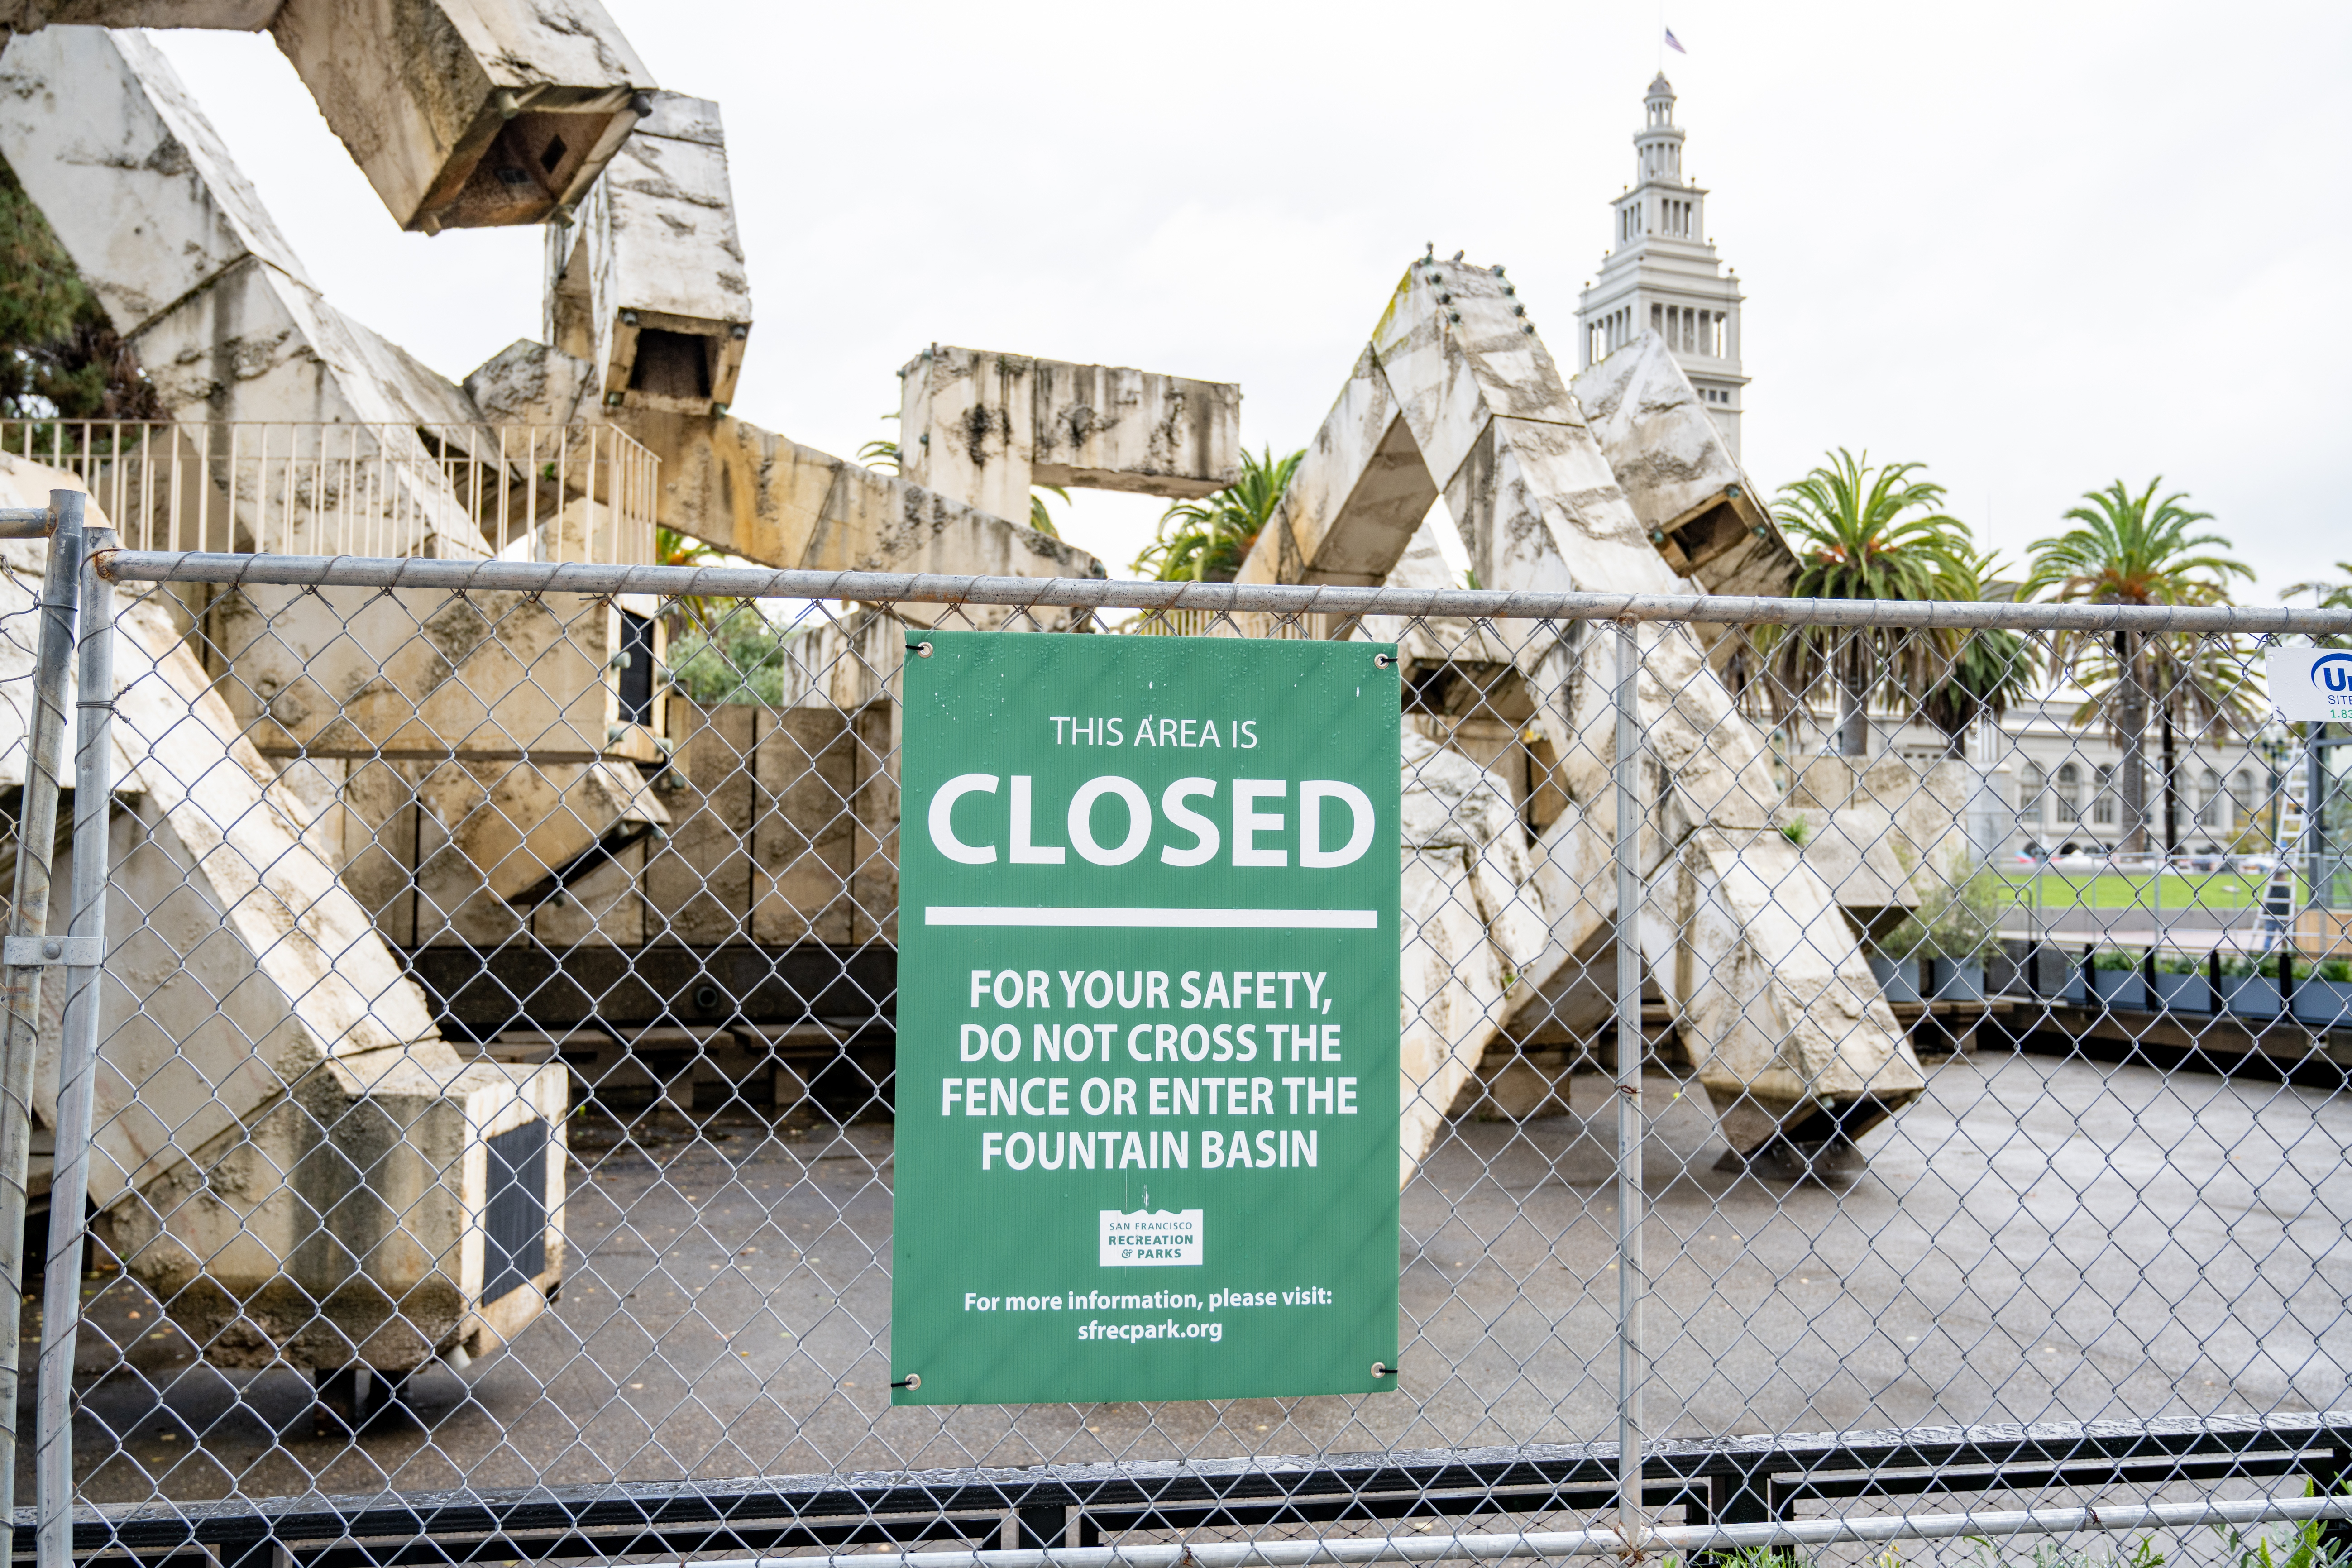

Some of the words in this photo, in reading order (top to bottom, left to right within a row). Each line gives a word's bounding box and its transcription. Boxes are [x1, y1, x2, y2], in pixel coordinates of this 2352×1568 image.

[1050, 717, 1123, 746] THIS
[1133, 718, 1221, 748] AREA
[1233, 720, 1257, 749] IS
[928, 773, 1375, 868] CLOSED
[971, 970, 1050, 1008] FOR
[1058, 970, 1170, 1009] YOUR
[1181, 970, 1332, 1014] SAFETY,
[961, 1023, 1021, 1062] DO
[1033, 1023, 1118, 1062] NOT
[1128, 1023, 1257, 1062] CROSS
[1266, 1024, 1341, 1061] THE
[942, 1077, 1069, 1116] FENCE
[1080, 1077, 1138, 1116] OR
[1149, 1077, 1274, 1115] ENTER
[1282, 1077, 1358, 1114] THE
[982, 1131, 1188, 1170] FOUNTAIN
[1201, 1130, 1317, 1168] BASIN
[1109, 1234, 1193, 1245] RECREATION
[1135, 1222, 1192, 1230] FRANCISCO
[1121, 1249, 1133, 1258] &
[1137, 1248, 1181, 1258] PARKS
[965, 1293, 1000, 1311] For
[1006, 1296, 1062, 1311] more
[1069, 1289, 1203, 1310] information,
[1209, 1288, 1277, 1312] please
[1282, 1286, 1332, 1305] visit:
[1078, 1319, 1222, 1343] sfrecpark.org
